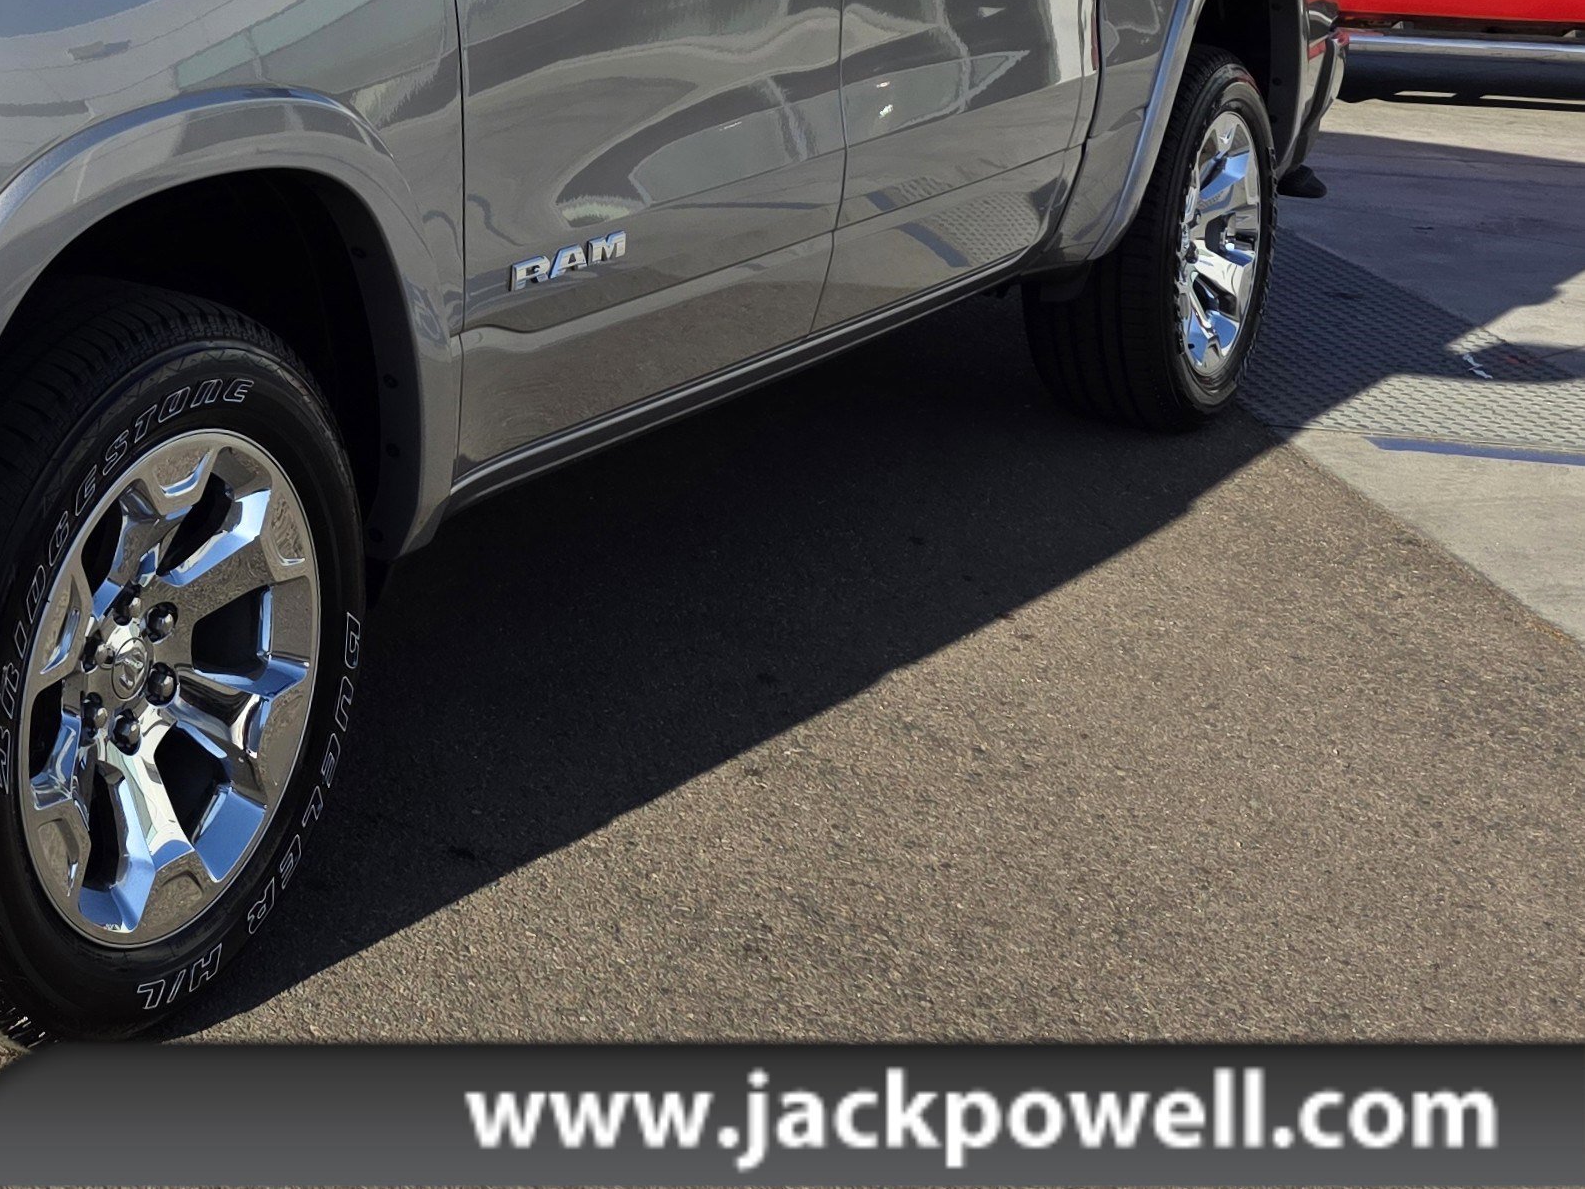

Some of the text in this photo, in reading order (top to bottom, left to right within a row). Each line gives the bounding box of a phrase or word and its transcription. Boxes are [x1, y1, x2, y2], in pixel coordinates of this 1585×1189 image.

[508, 229, 627, 292] RAM
[136, 611, 361, 1010] DUELER H/L
